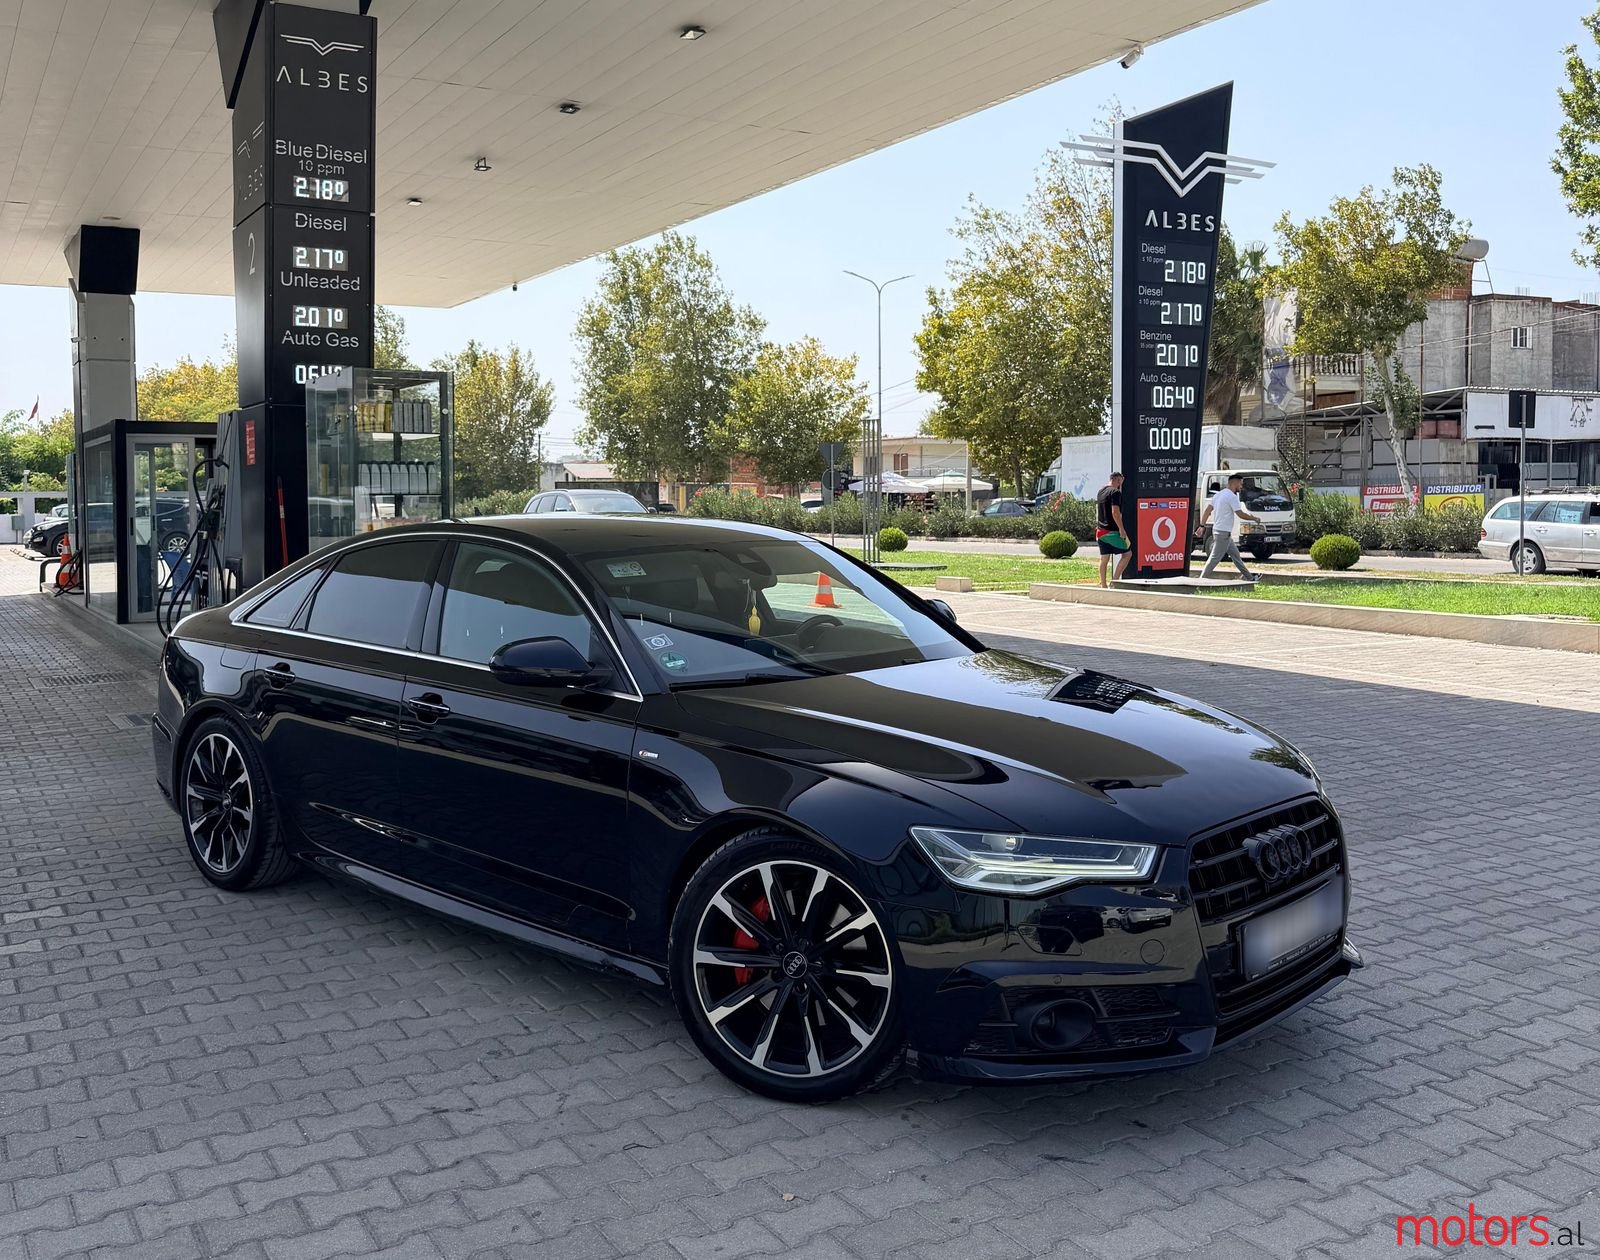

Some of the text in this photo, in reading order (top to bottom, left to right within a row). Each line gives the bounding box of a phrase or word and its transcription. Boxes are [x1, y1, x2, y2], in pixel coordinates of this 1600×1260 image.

[276, 65, 368, 93] ALBES
[275, 139, 367, 164] Blue Diesel
[298, 160, 345, 176] 10 ppm
[295, 212, 347, 232] Diesel
[1144, 209, 1215, 232] ALBES
[248, 232, 256, 275] 2
[1141, 243, 1167, 254] Diesel
[280, 271, 360, 291] Unleaded
[1138, 285, 1164, 297] Diesel
[281, 330, 359, 348] Auto Gas
[1140, 330, 1172, 342] Benzine
[1140, 372, 1177, 383] Auto Gas
[1139, 414, 1168, 427] Energy
[1427, 484, 1482, 494] DISTRIBUTOR
[1144, 551, 1184, 562] vodafone
